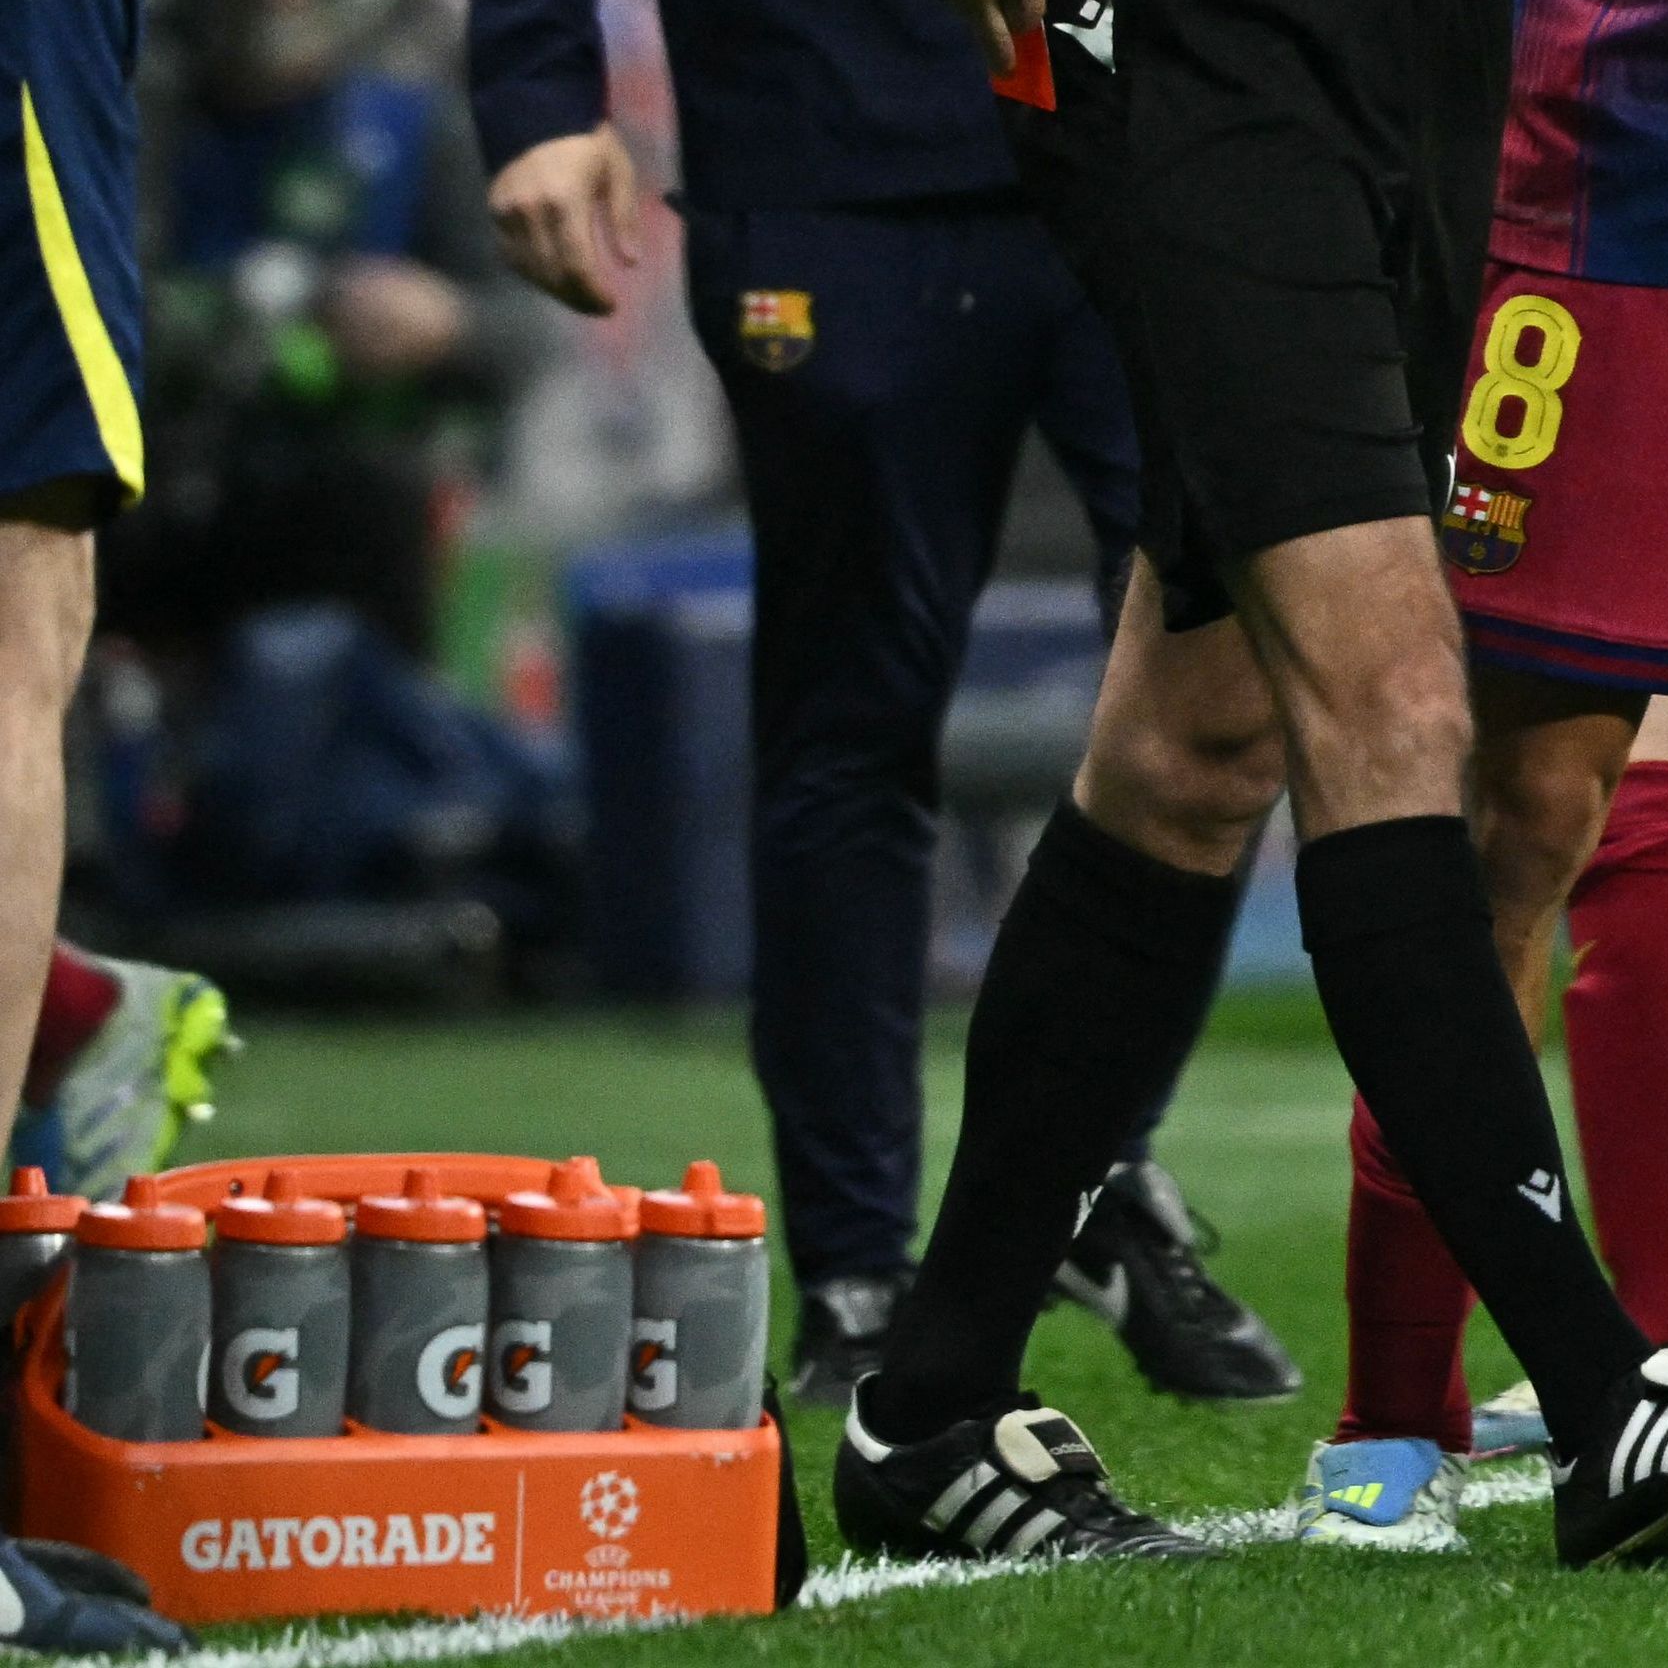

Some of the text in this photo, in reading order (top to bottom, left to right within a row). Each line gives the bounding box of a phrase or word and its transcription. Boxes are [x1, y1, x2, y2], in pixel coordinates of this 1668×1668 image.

[1461, 294, 1583, 470] 8
[223, 1326, 299, 1420] G
[417, 1323, 485, 1420] G
[495, 1319, 552, 1413] G
[180, 1512, 496, 1571] GATORADE
[544, 1568, 671, 1591] CHAMPIONS
